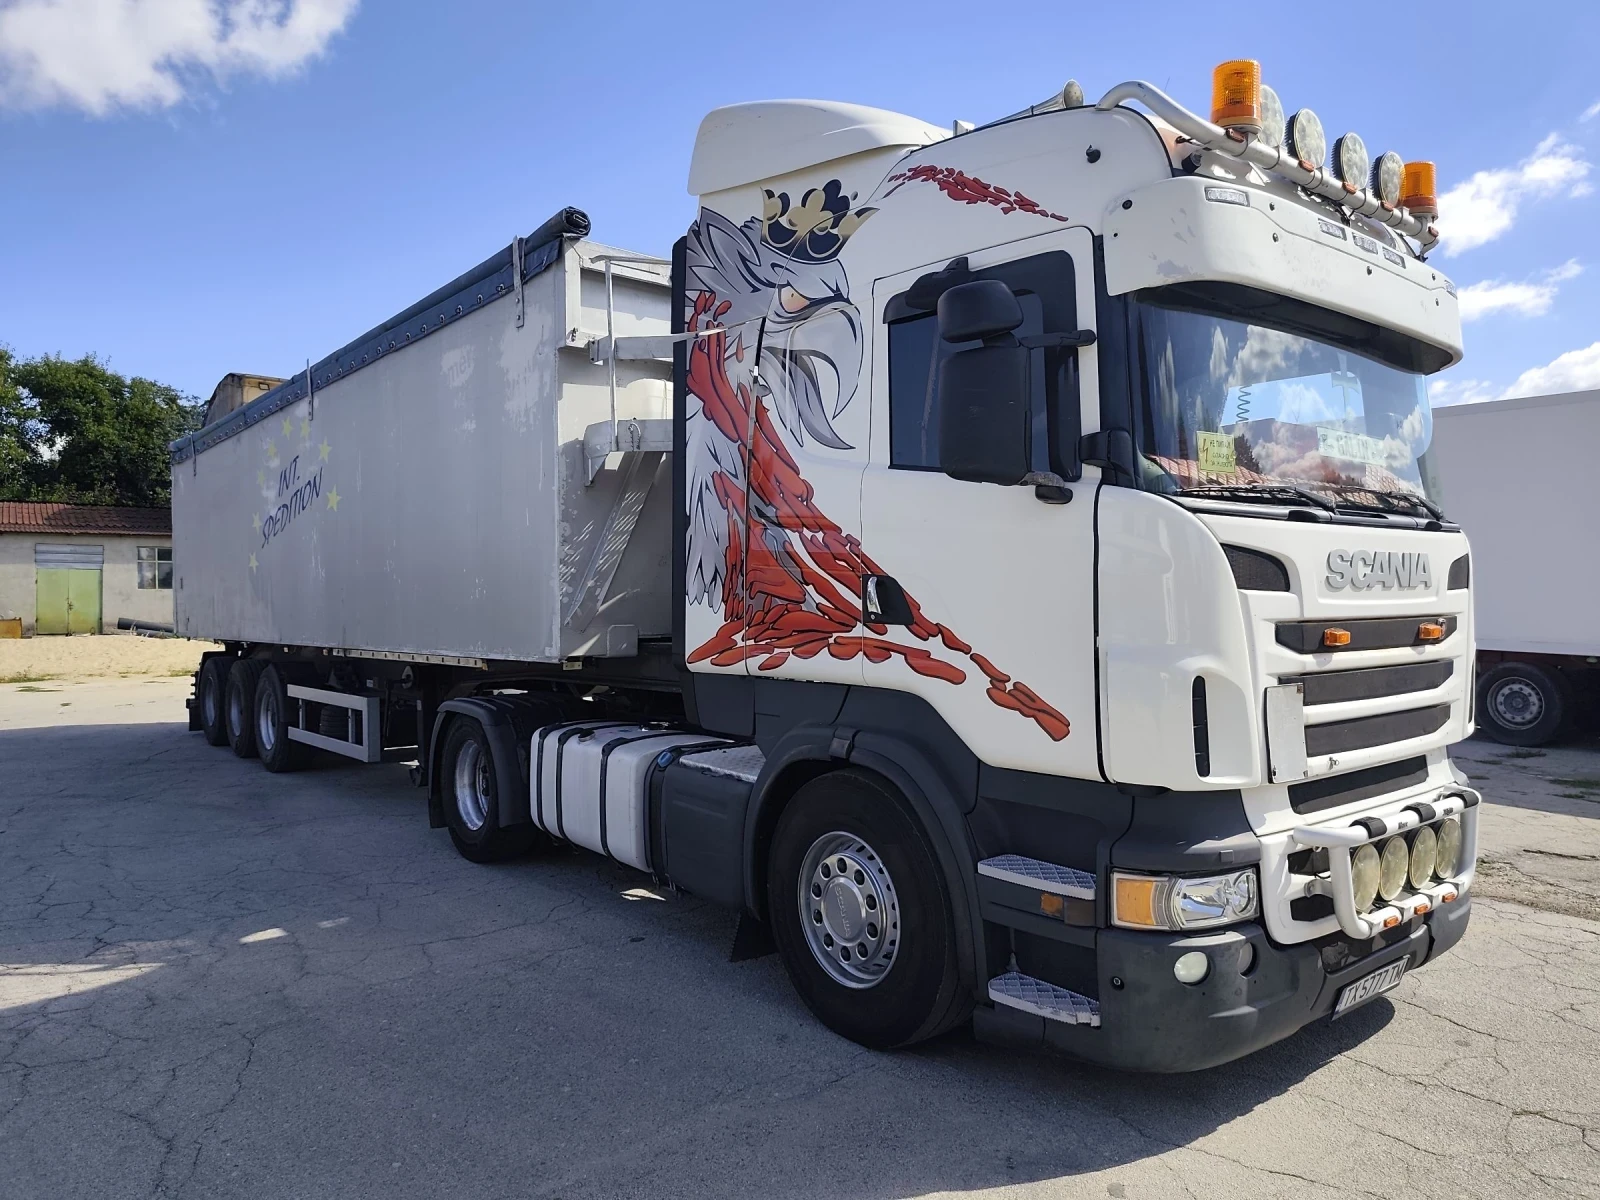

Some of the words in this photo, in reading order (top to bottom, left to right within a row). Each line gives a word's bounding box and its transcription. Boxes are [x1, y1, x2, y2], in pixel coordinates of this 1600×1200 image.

[278, 455, 300, 497] INT.
[261, 466, 323, 549] SPEDITION
[1324, 549, 1432, 592] SCANIA
